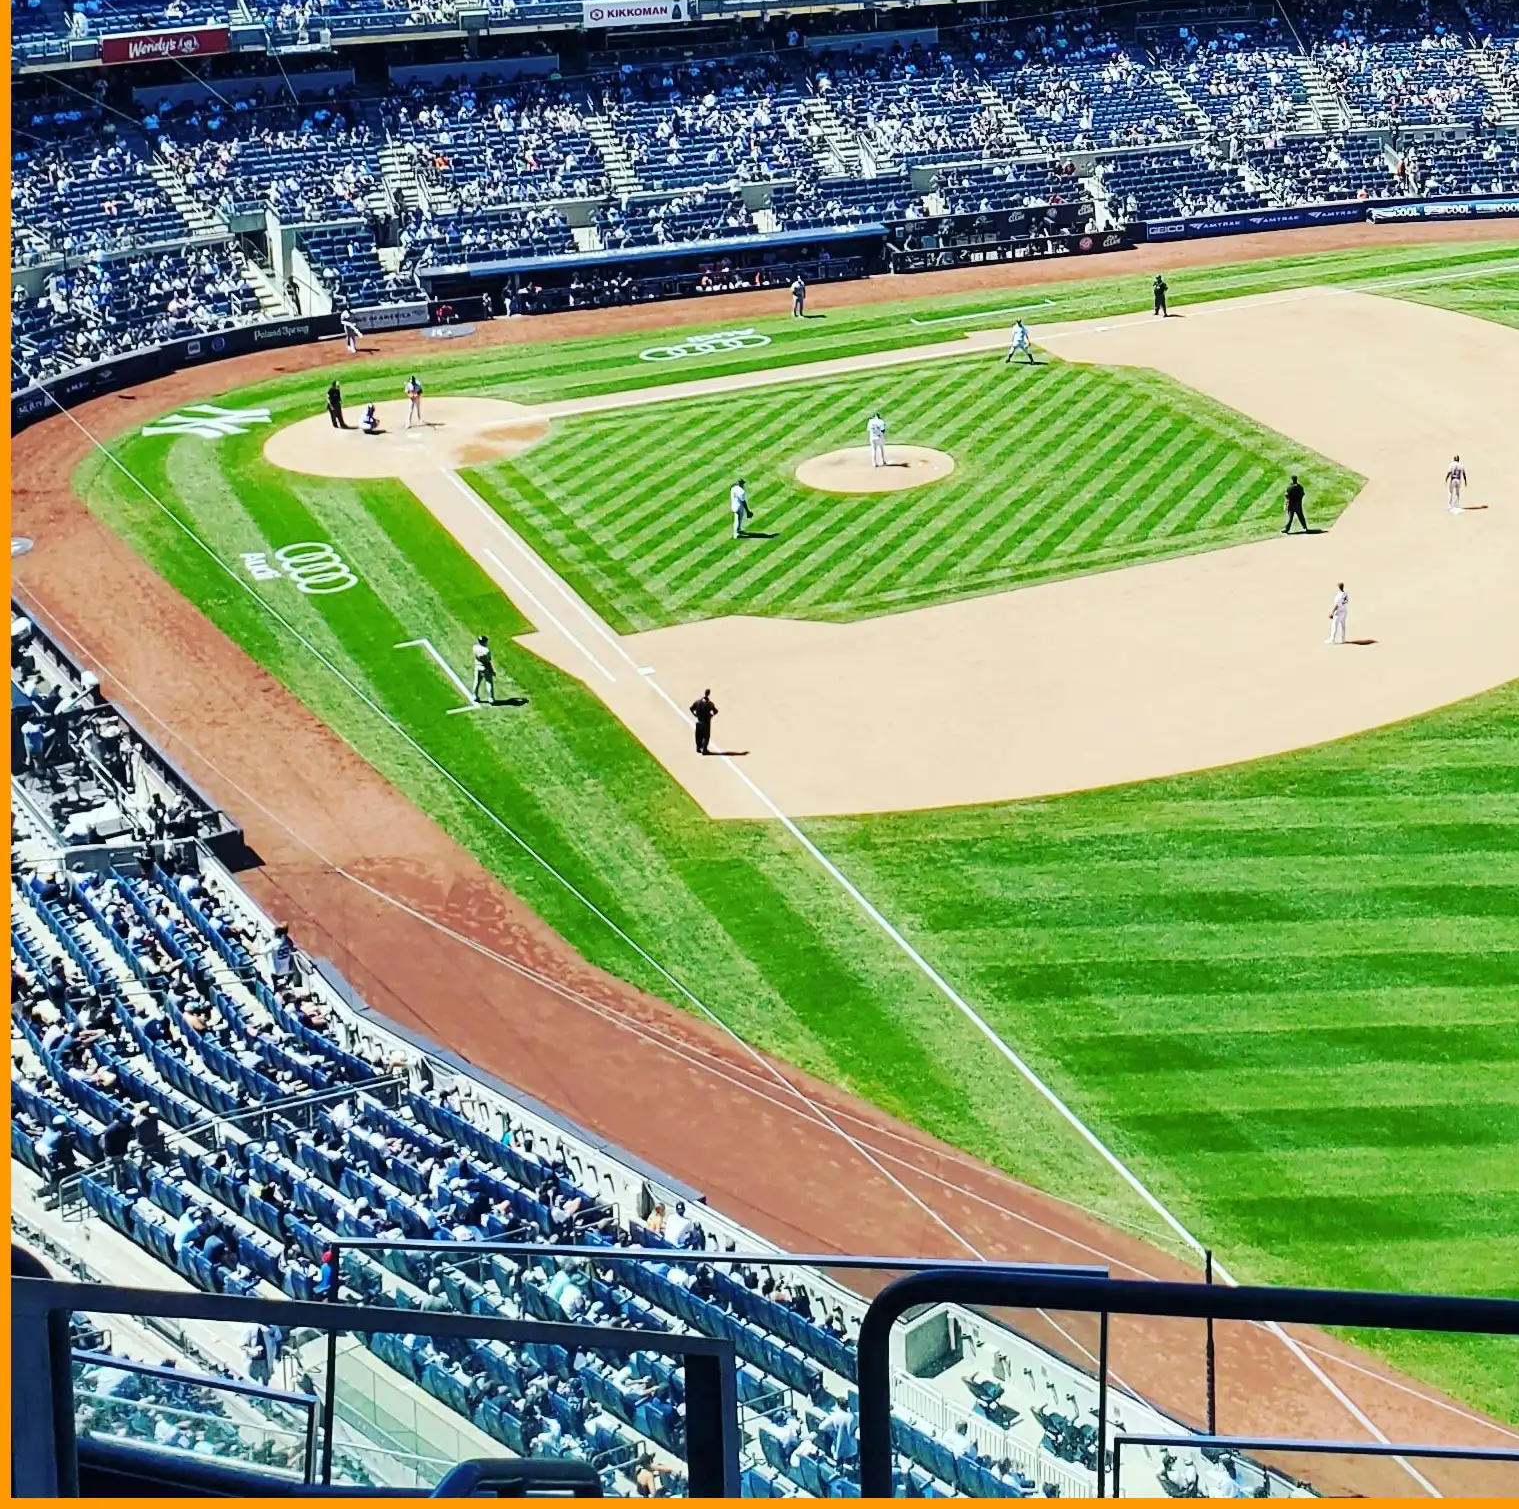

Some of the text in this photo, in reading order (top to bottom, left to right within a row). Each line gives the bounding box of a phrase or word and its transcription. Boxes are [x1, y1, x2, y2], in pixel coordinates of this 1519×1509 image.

[607, 6, 668, 18] KIKKOMAN
[128, 39, 176, 59] Wendy's
[1262, 215, 1300, 223] AMTRAK
[1149, 224, 1185, 235] GEICO
[1203, 221, 1241, 229] AMTRAK
[254, 330, 281, 341] Poland
